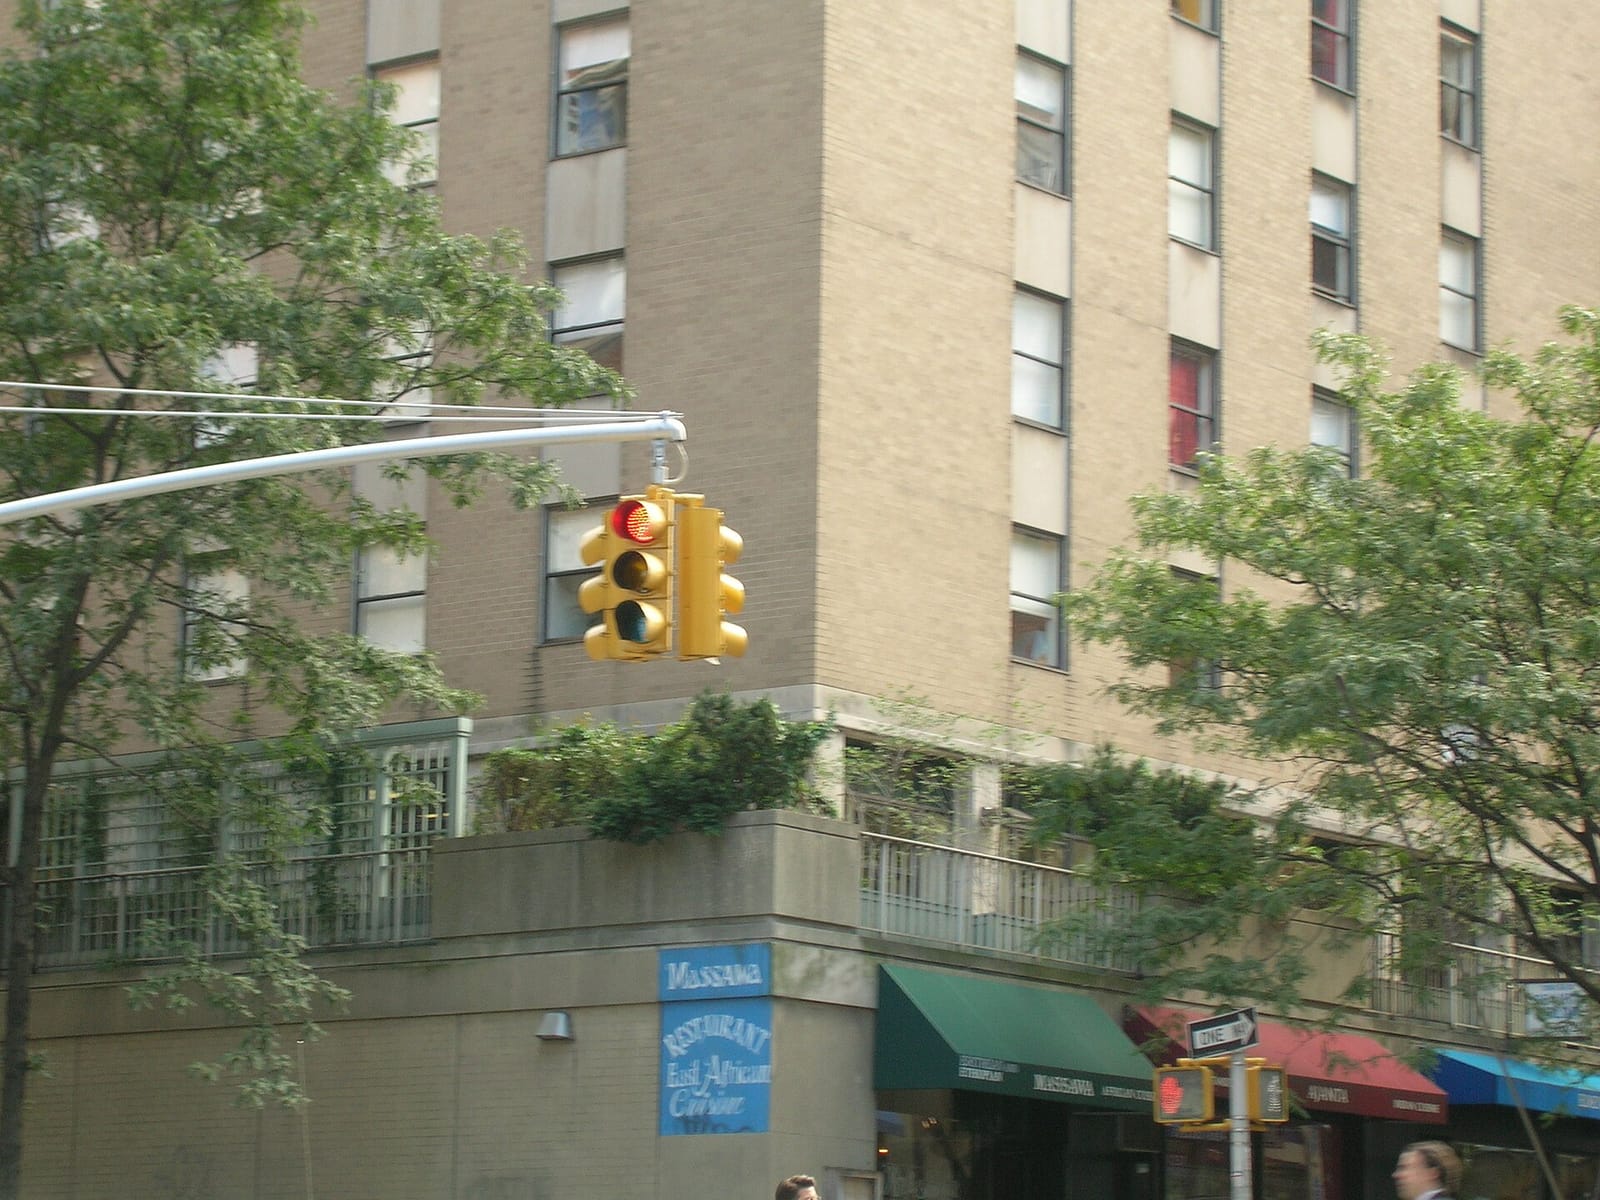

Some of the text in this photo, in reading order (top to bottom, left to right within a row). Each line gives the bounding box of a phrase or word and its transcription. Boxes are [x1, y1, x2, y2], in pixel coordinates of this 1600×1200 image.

[663, 1014, 771, 1056] RESTAURANT
[1199, 1027, 1224, 1045] ONE
[1033, 1074, 1095, 1096] MASSAWA
